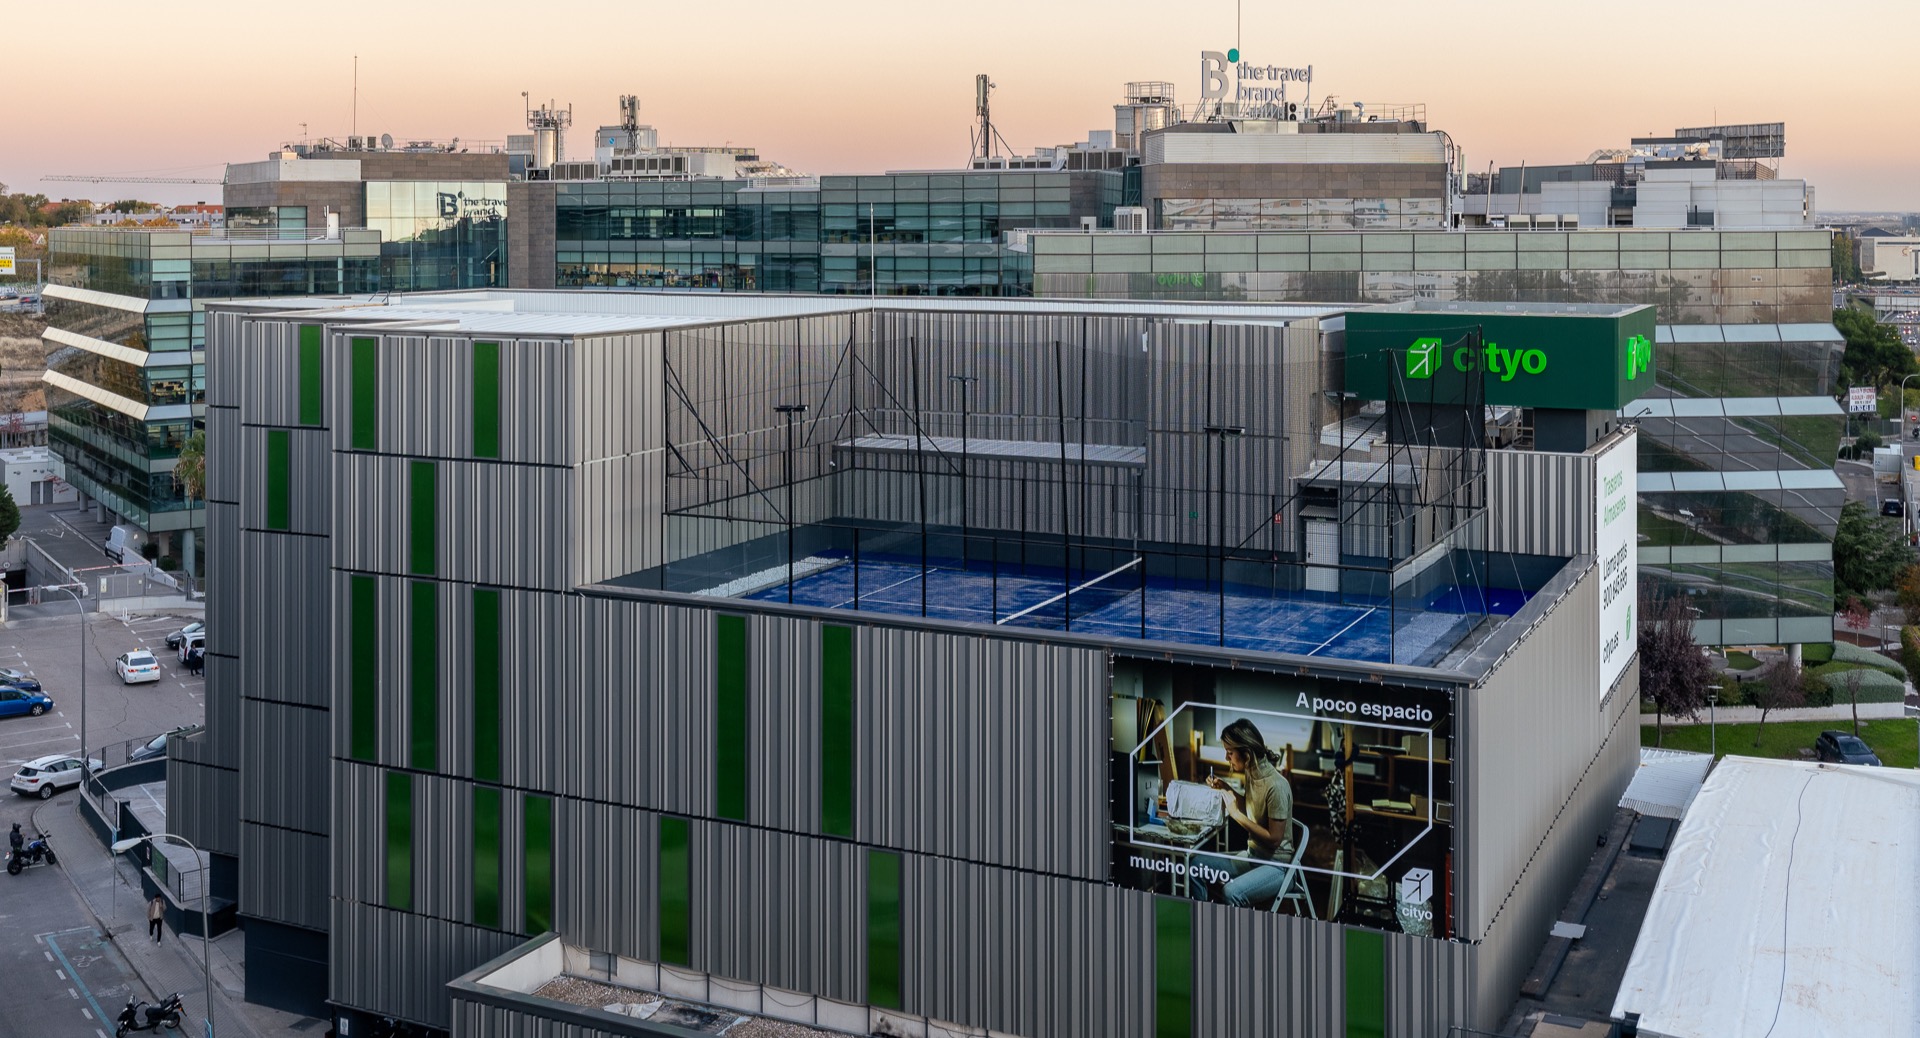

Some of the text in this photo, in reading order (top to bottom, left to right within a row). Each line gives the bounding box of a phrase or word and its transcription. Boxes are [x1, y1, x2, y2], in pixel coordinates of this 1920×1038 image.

[1201, 50, 1230, 99] B
[1236, 61, 1313, 83] the travel
[1237, 82, 1287, 101] brand
[463, 197, 479, 207] the
[1603, 470, 1623, 498] Trasteros
[1603, 494, 1626, 528] Almacenes
[1603, 539, 1628, 581] Llama gratis
[1603, 582, 1613, 610] 900
[1295, 691, 1434, 722] A poco espacio
[1129, 853, 1234, 885] mucho cityo.
[1401, 905, 1433, 922] cityo
